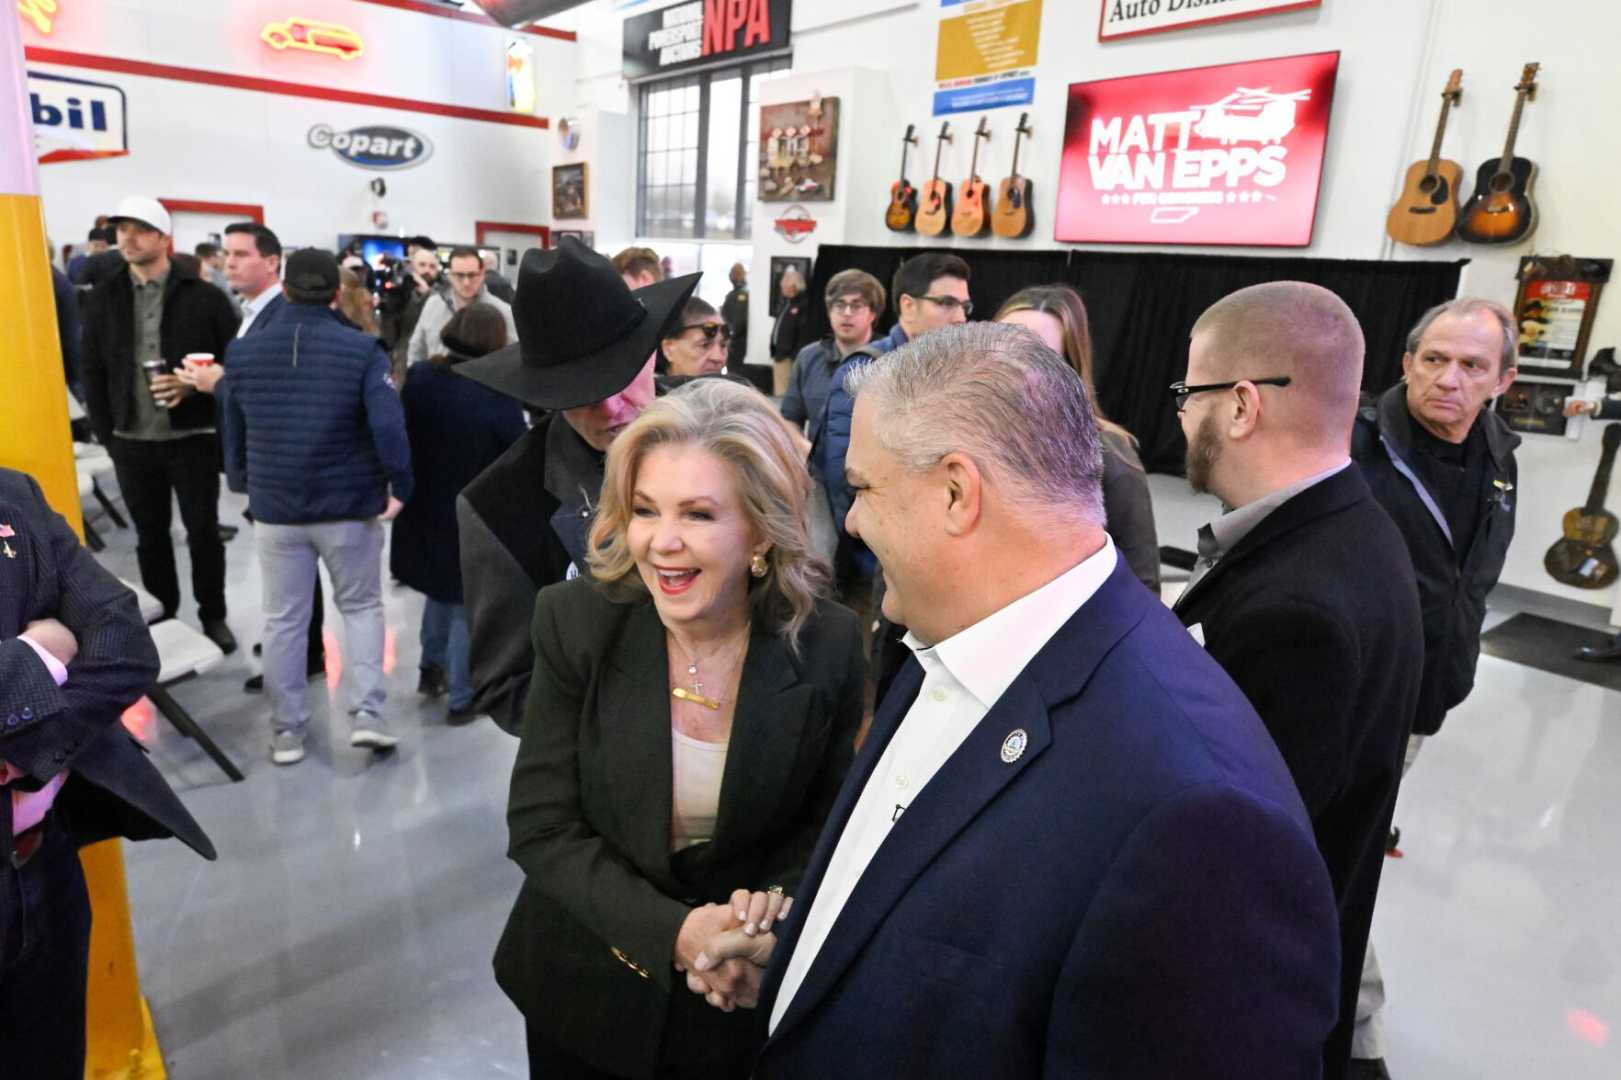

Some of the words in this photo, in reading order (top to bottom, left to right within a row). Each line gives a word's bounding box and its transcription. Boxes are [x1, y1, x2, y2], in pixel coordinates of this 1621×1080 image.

[703, 0, 770, 56] NPA
[1109, 0, 1161, 22] Auto
[307, 124, 417, 158] Copart
[1090, 111, 1201, 155] MATT
[1088, 151, 1166, 190] VAN
[1171, 145, 1288, 188] EPPS
